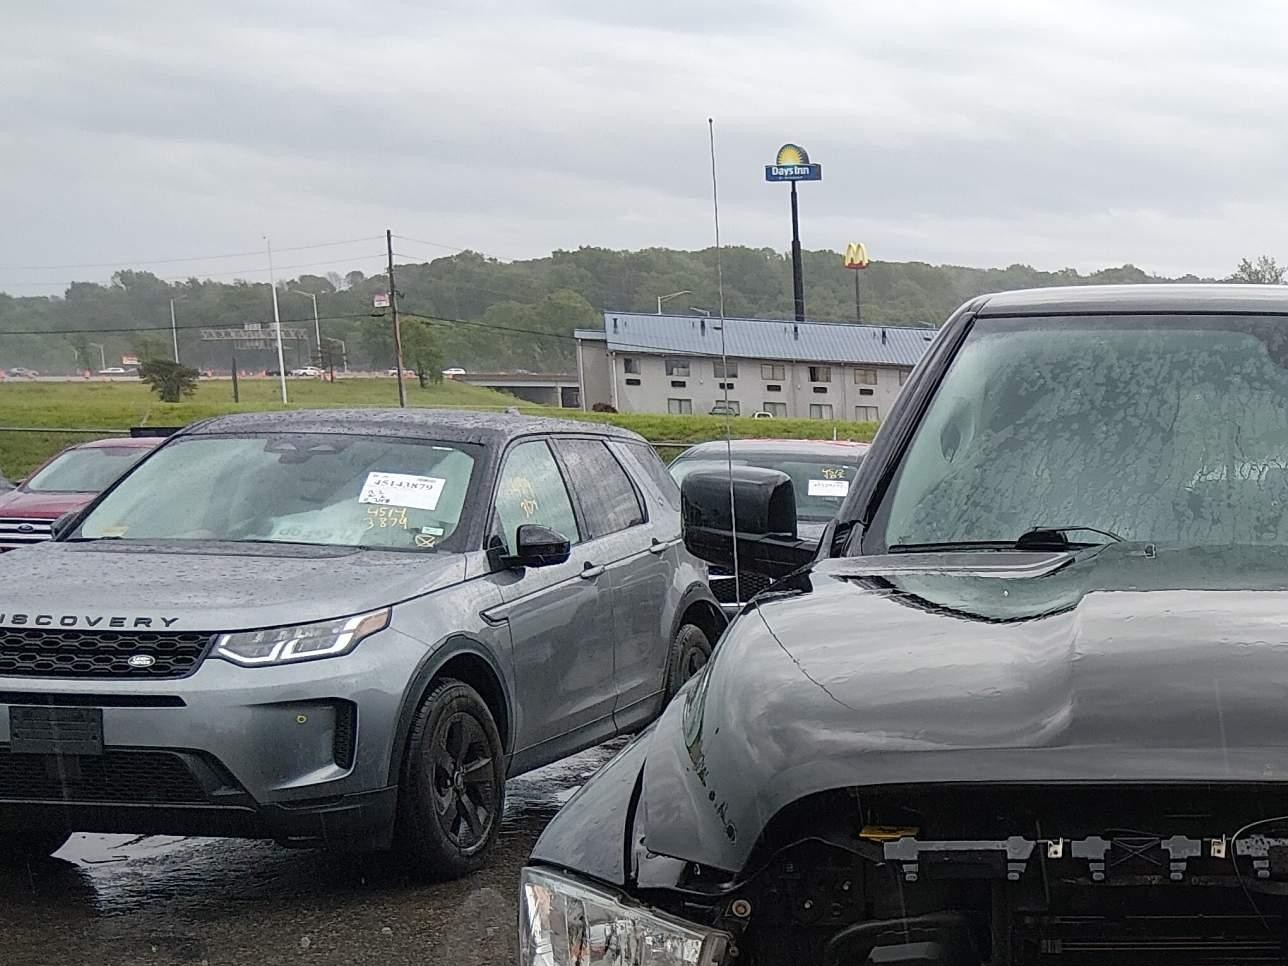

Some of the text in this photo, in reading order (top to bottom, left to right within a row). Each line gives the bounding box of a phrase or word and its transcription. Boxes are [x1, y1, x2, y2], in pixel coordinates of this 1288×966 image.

[771, 166, 810, 176] Days Inn
[374, 480, 433, 490] 45143879
[367, 507, 407, 518] 4514
